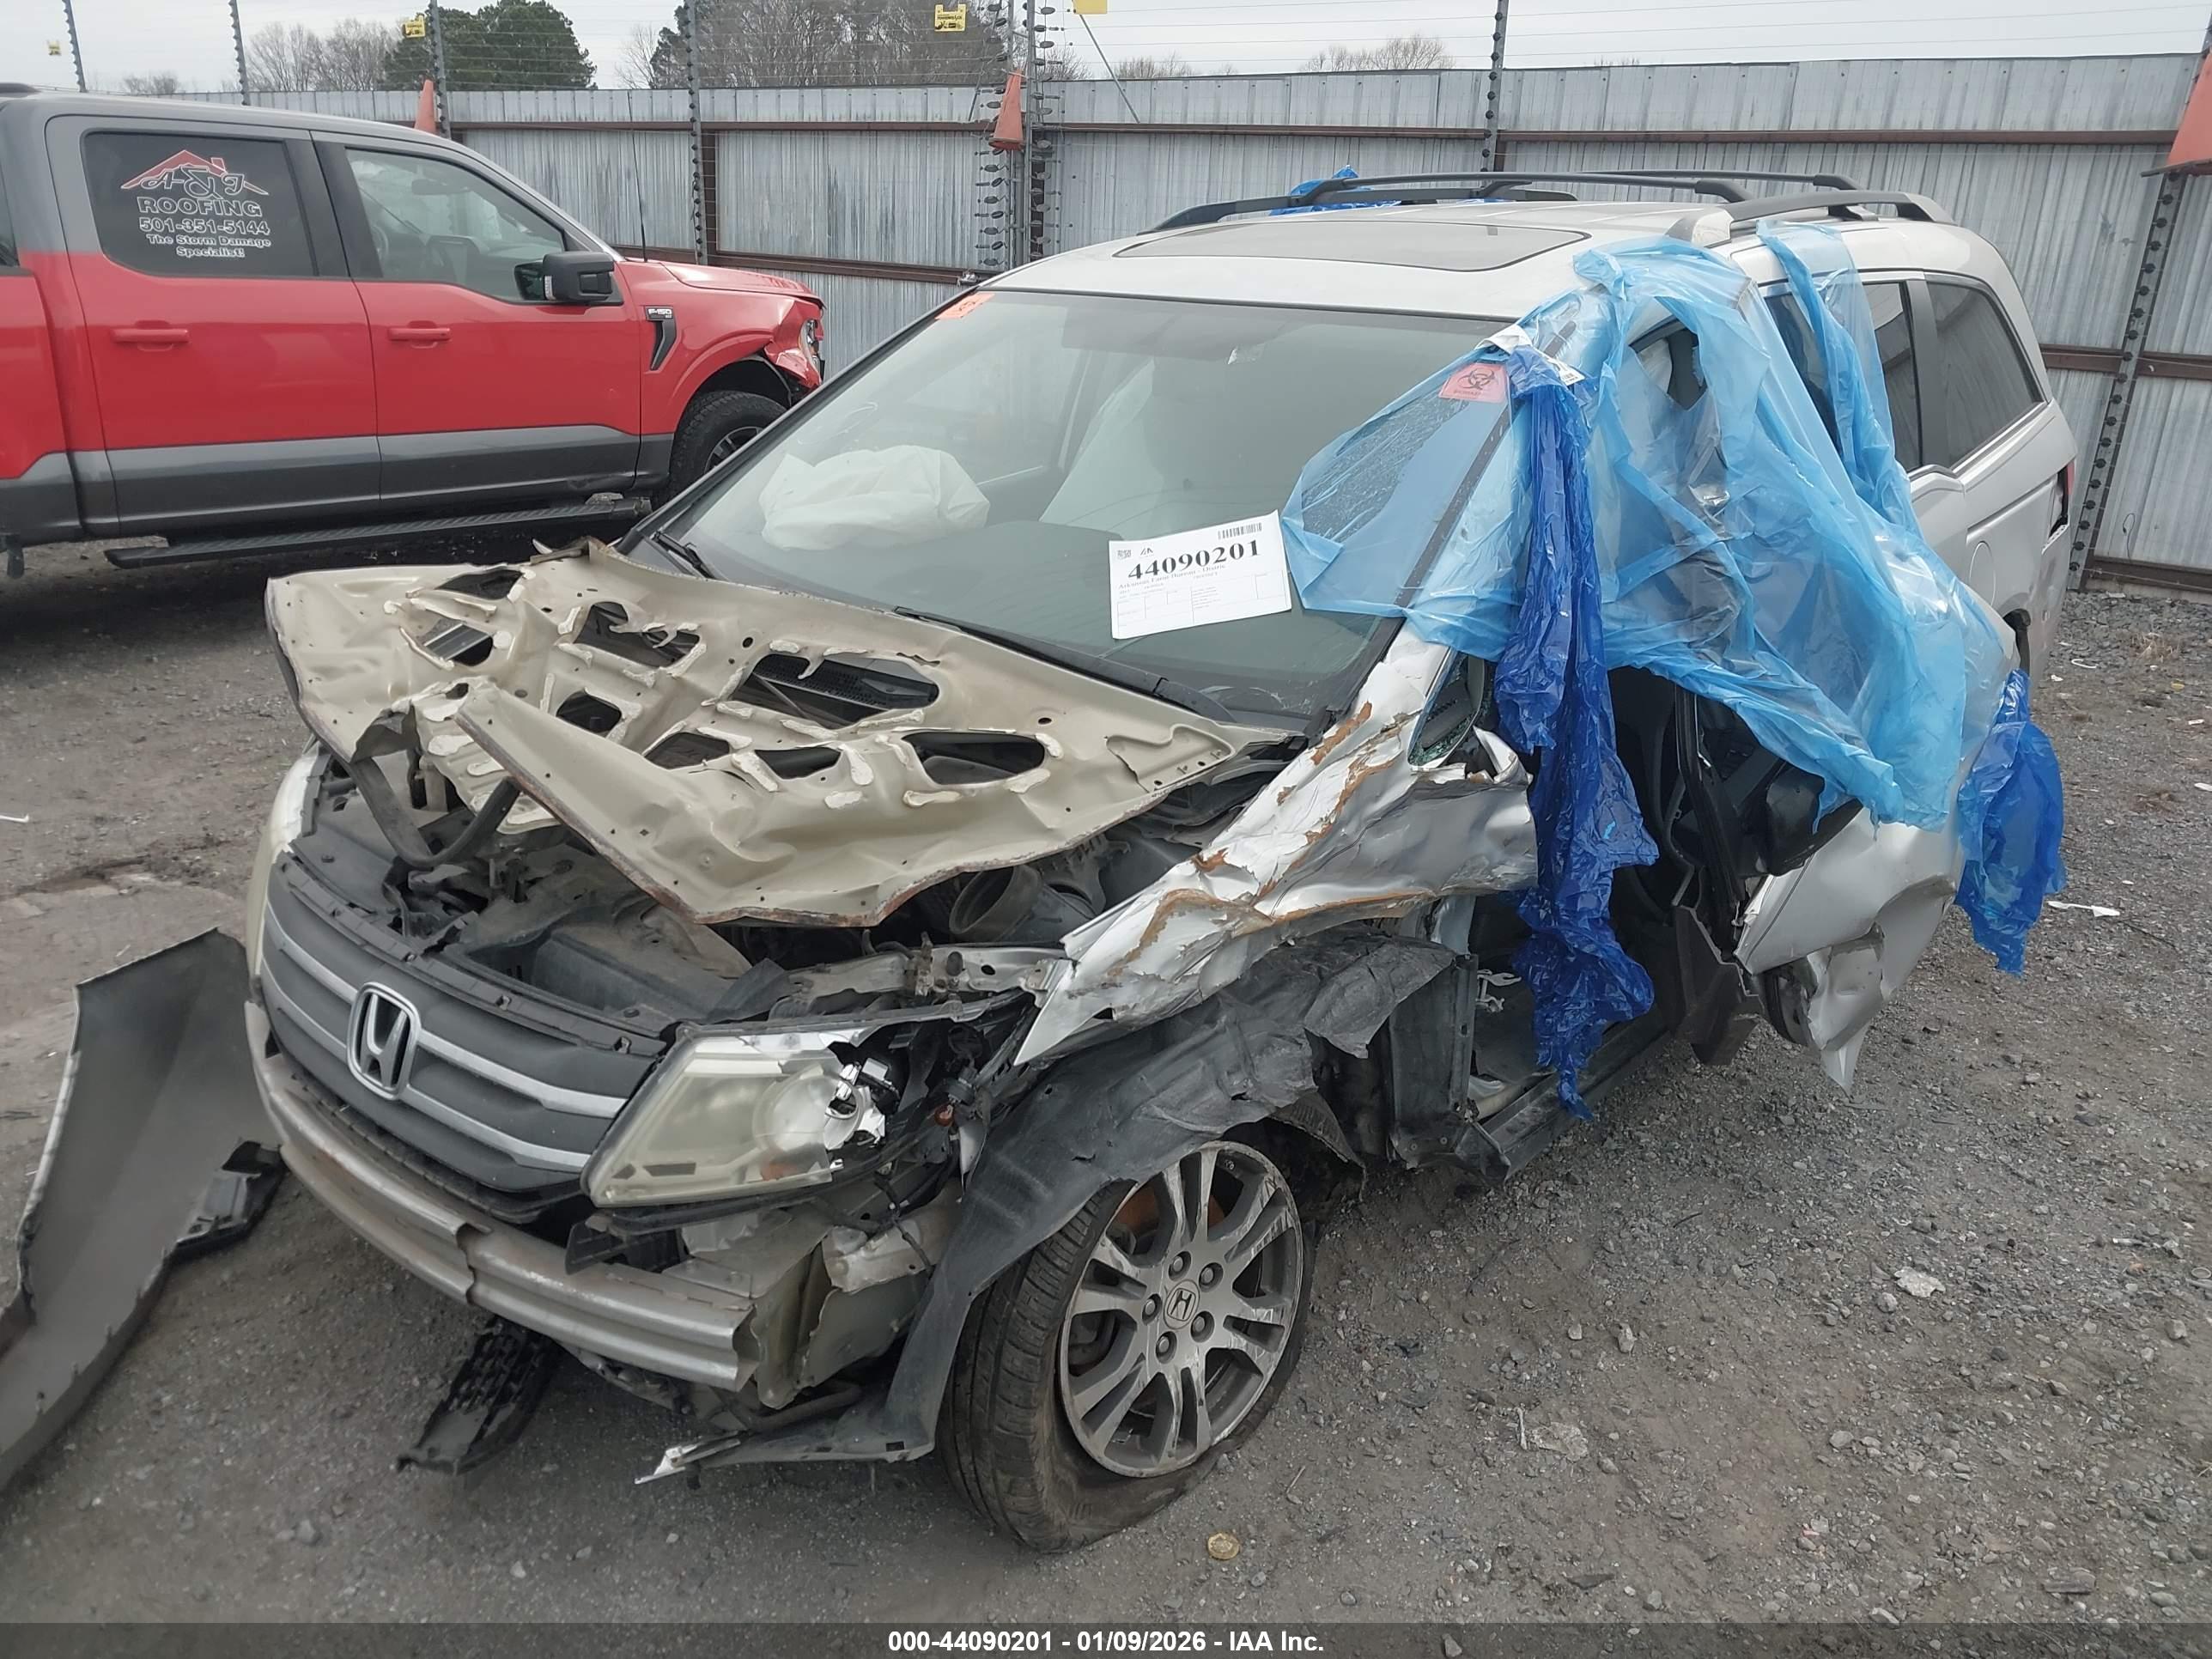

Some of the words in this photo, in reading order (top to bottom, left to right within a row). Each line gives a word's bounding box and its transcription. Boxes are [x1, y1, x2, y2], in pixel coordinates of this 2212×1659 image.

[137, 197, 262, 217] ROOFING
[139, 217, 270, 235] 501-351-5144
[146, 234, 173, 245] The
[175, 234, 216, 246] Storm
[218, 236, 271, 249] Damage
[175, 246, 246, 258] Specialist!
[1127, 539, 1261, 580] 44090201
